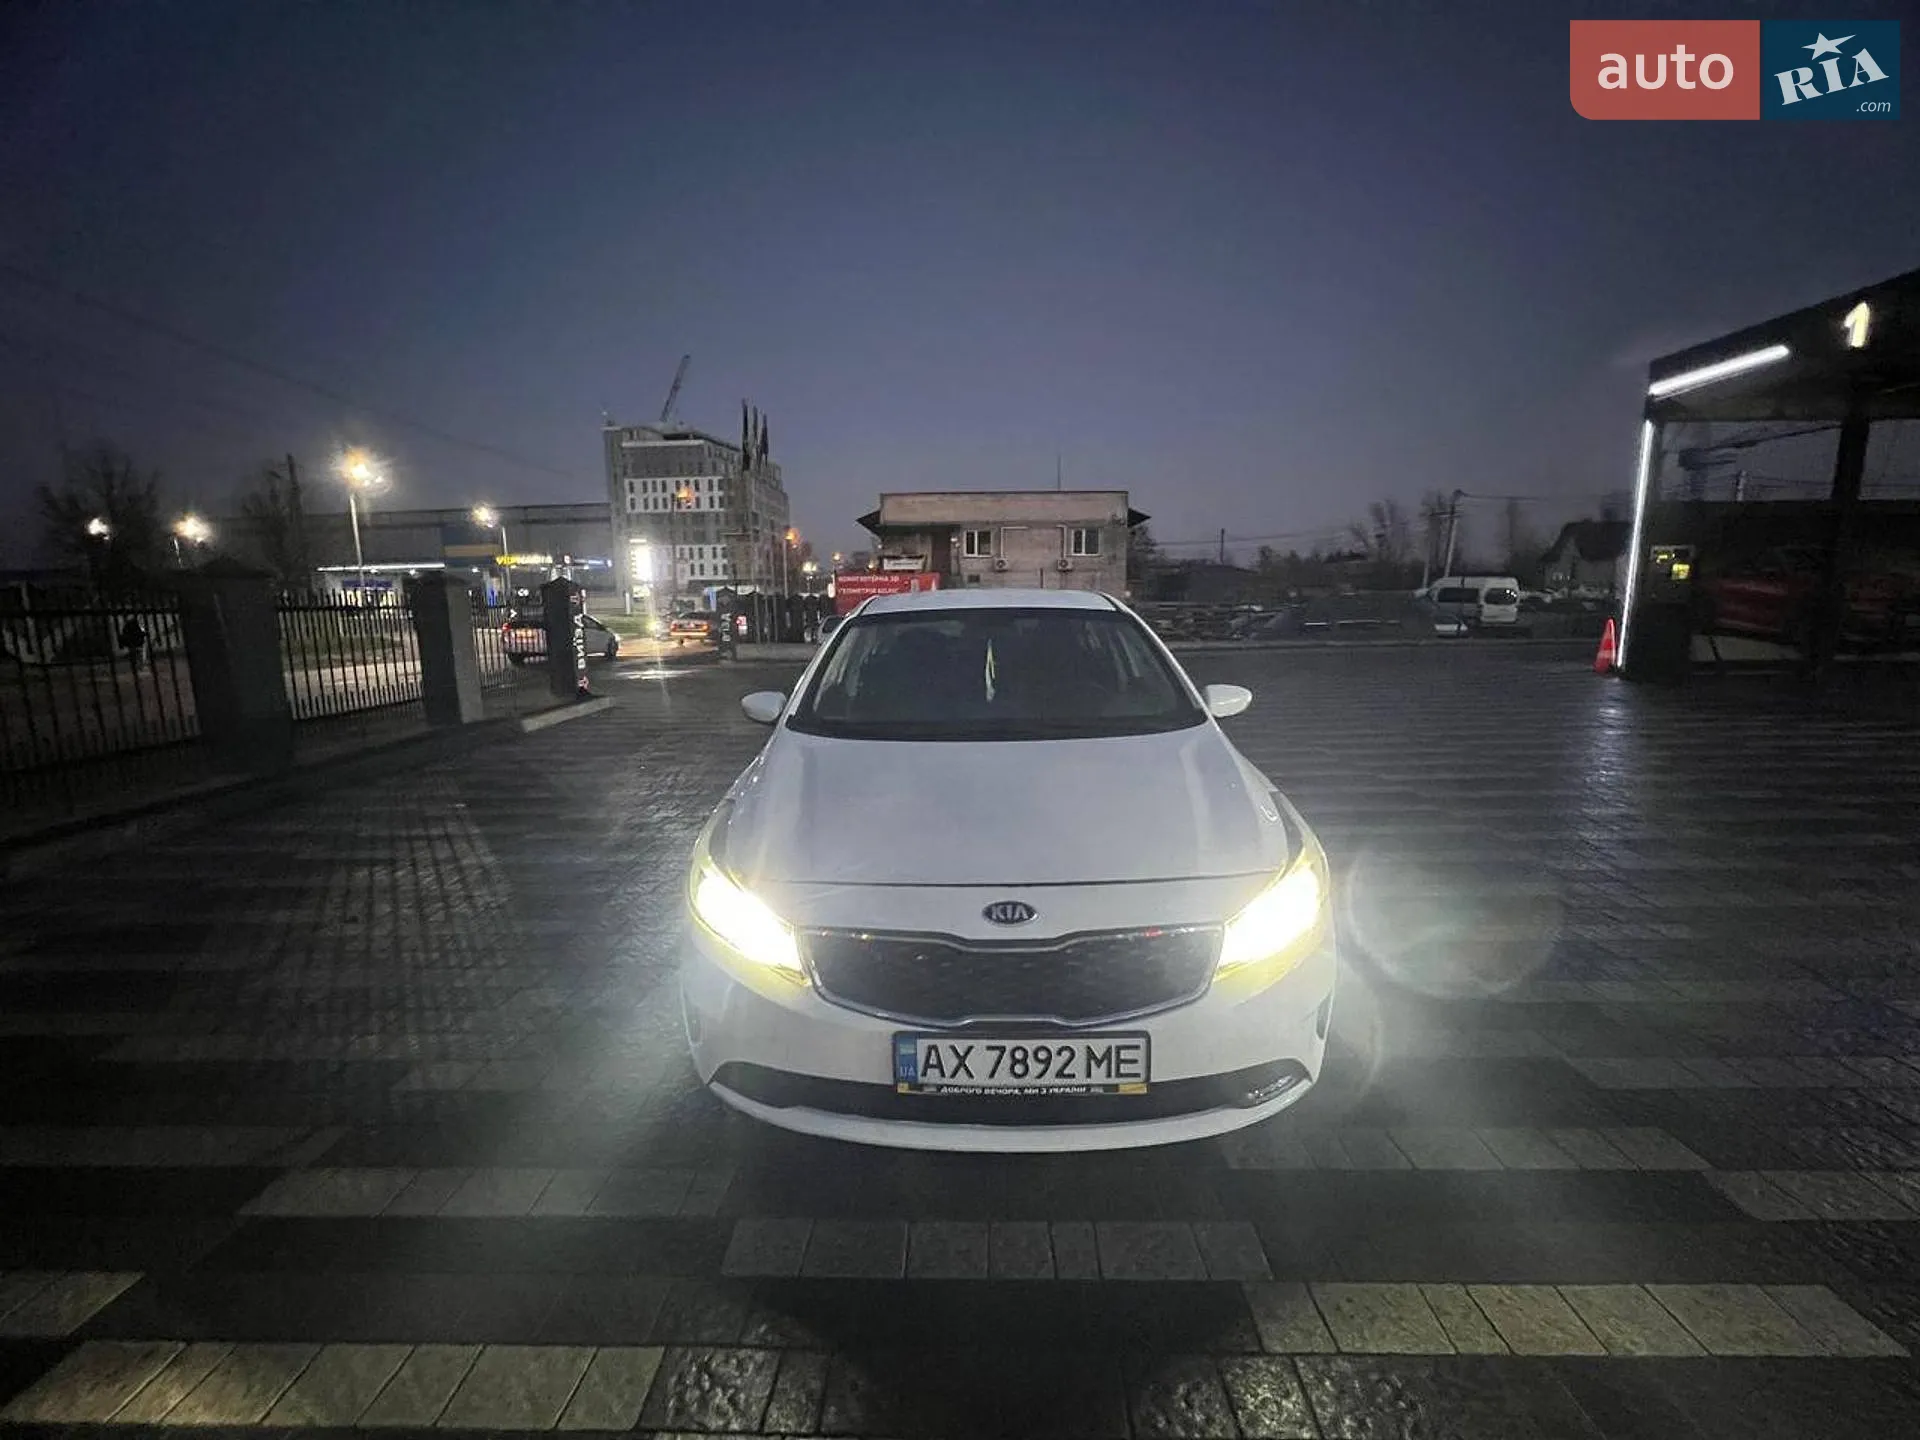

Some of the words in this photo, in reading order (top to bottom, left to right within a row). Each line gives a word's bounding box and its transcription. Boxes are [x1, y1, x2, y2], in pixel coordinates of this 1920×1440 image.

[1843, 301, 1870, 348] 1
[991, 904, 1029, 921] KIA
[900, 1065, 916, 1077] UA
[921, 1044, 975, 1079] AX
[985, 1045, 1077, 1080] 7892
[1086, 1045, 1141, 1078] ME
